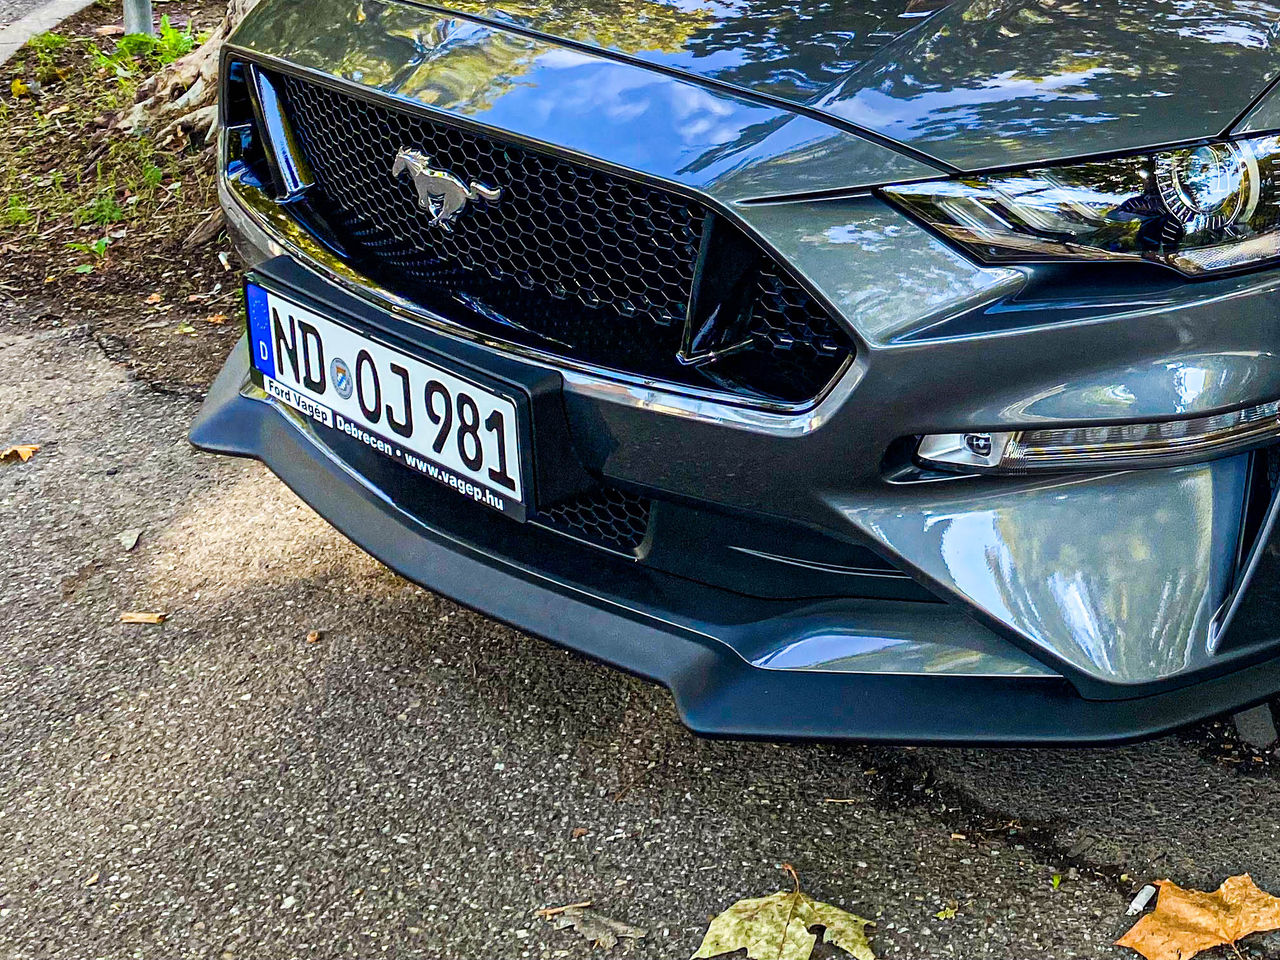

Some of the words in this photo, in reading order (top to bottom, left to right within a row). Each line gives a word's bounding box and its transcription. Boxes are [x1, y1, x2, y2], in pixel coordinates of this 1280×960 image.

[259, 340, 268, 361] D
[272, 306, 327, 395] ND
[355, 349, 413, 439] OJ
[424, 380, 516, 492] 981
[268, 380, 291, 403] Ford
[293, 393, 328, 422] Vagép
[336, 414, 393, 457] Debrecen
[404, 452, 504, 511] www.vagep.hu
